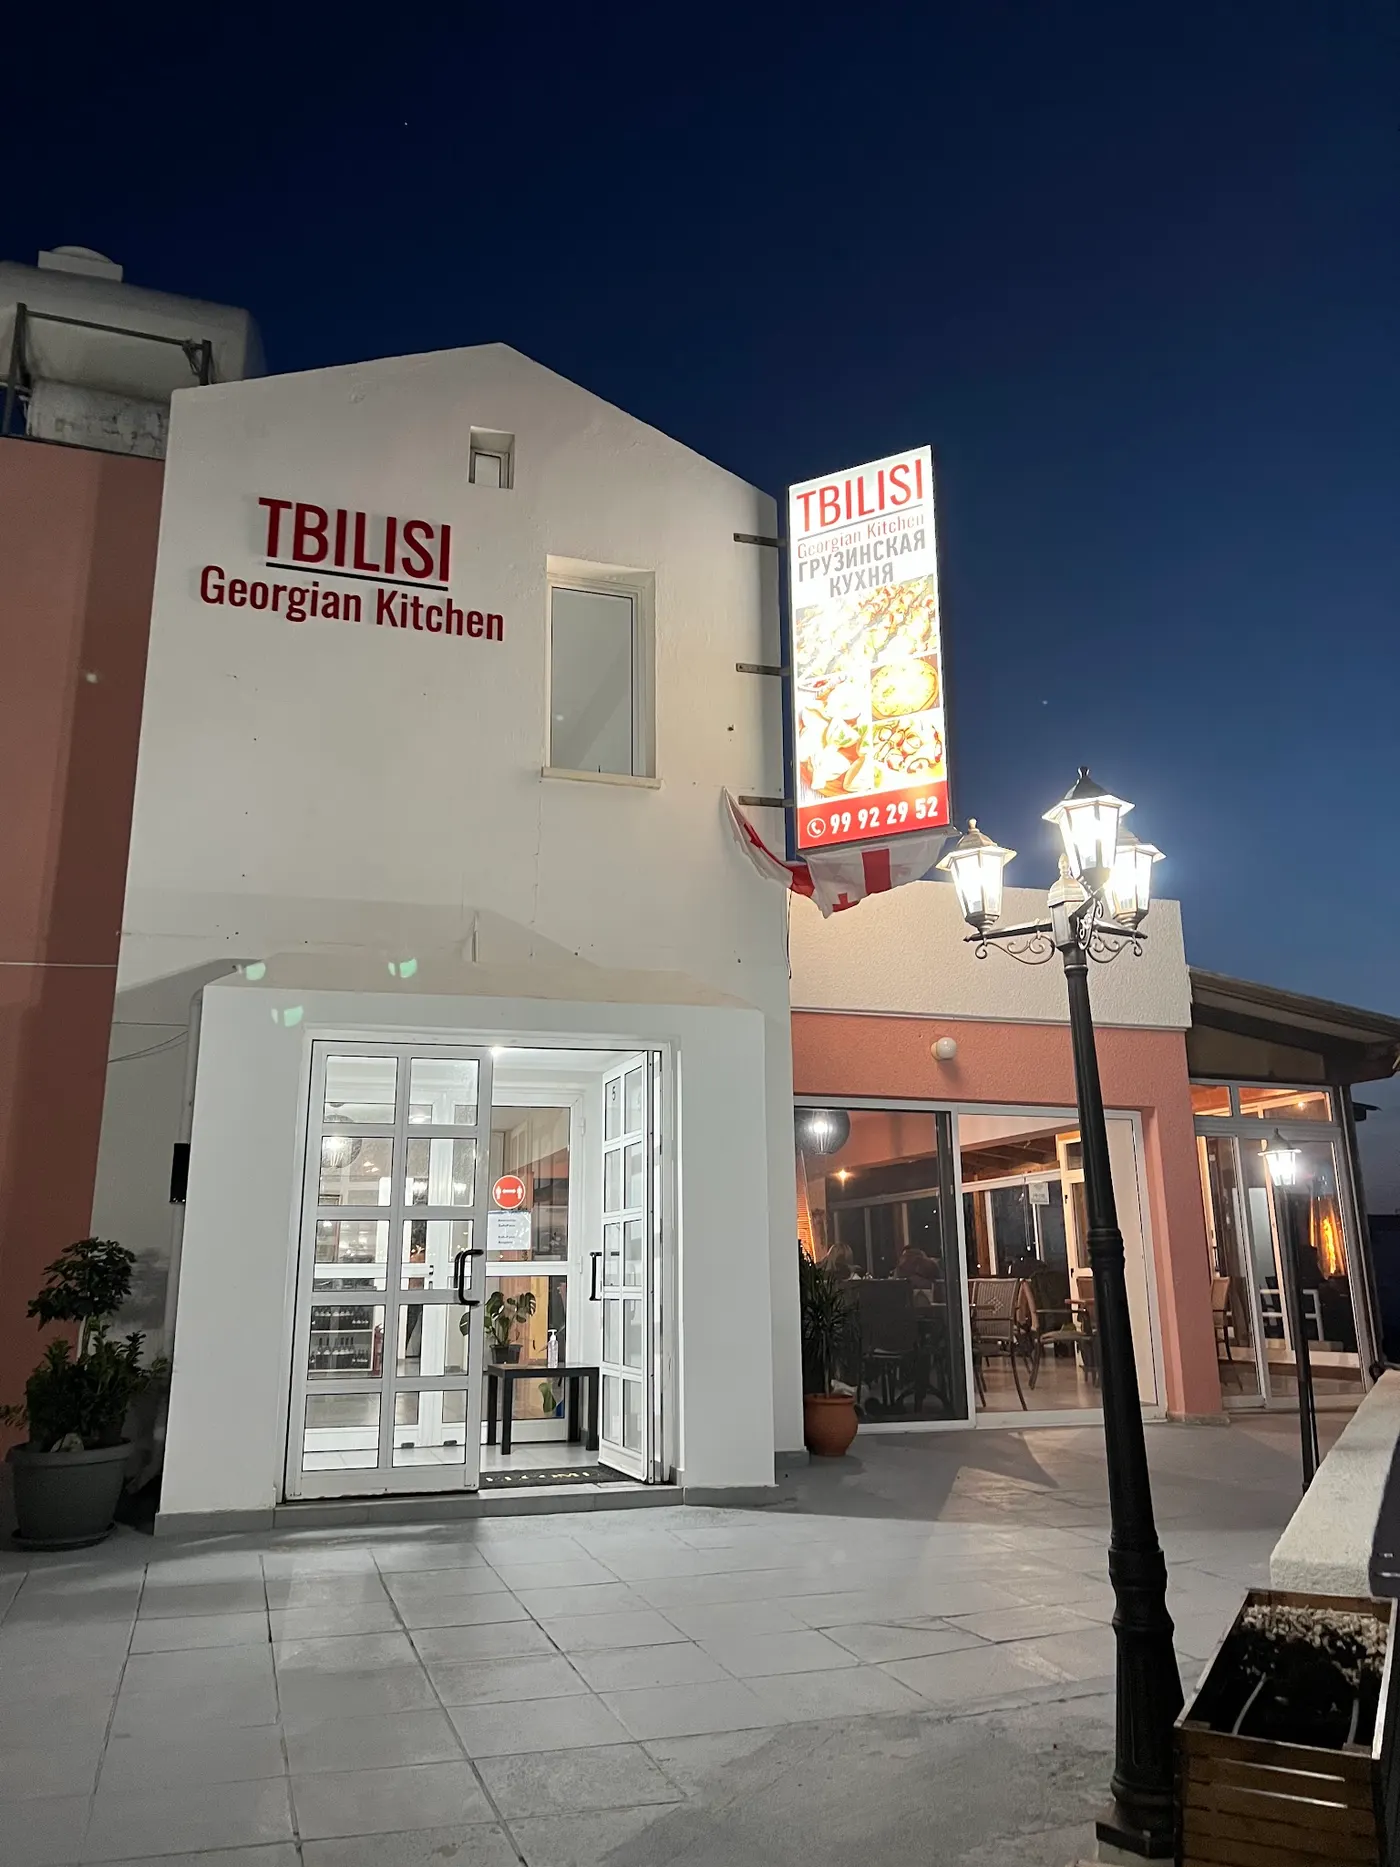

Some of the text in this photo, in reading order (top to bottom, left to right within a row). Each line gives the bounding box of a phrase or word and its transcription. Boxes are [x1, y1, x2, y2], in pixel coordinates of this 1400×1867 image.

[796, 458, 923, 532] TBILISI
[258, 496, 451, 582] TBILISI
[797, 513, 924, 559] Georgian Kitchen
[799, 528, 926, 582] ГРУЗИНСКАЯ
[200, 565, 504, 642] Georgian Kitchen
[830, 562, 894, 598] КУХНЯ
[830, 795, 939, 834] 99 92 29 52
